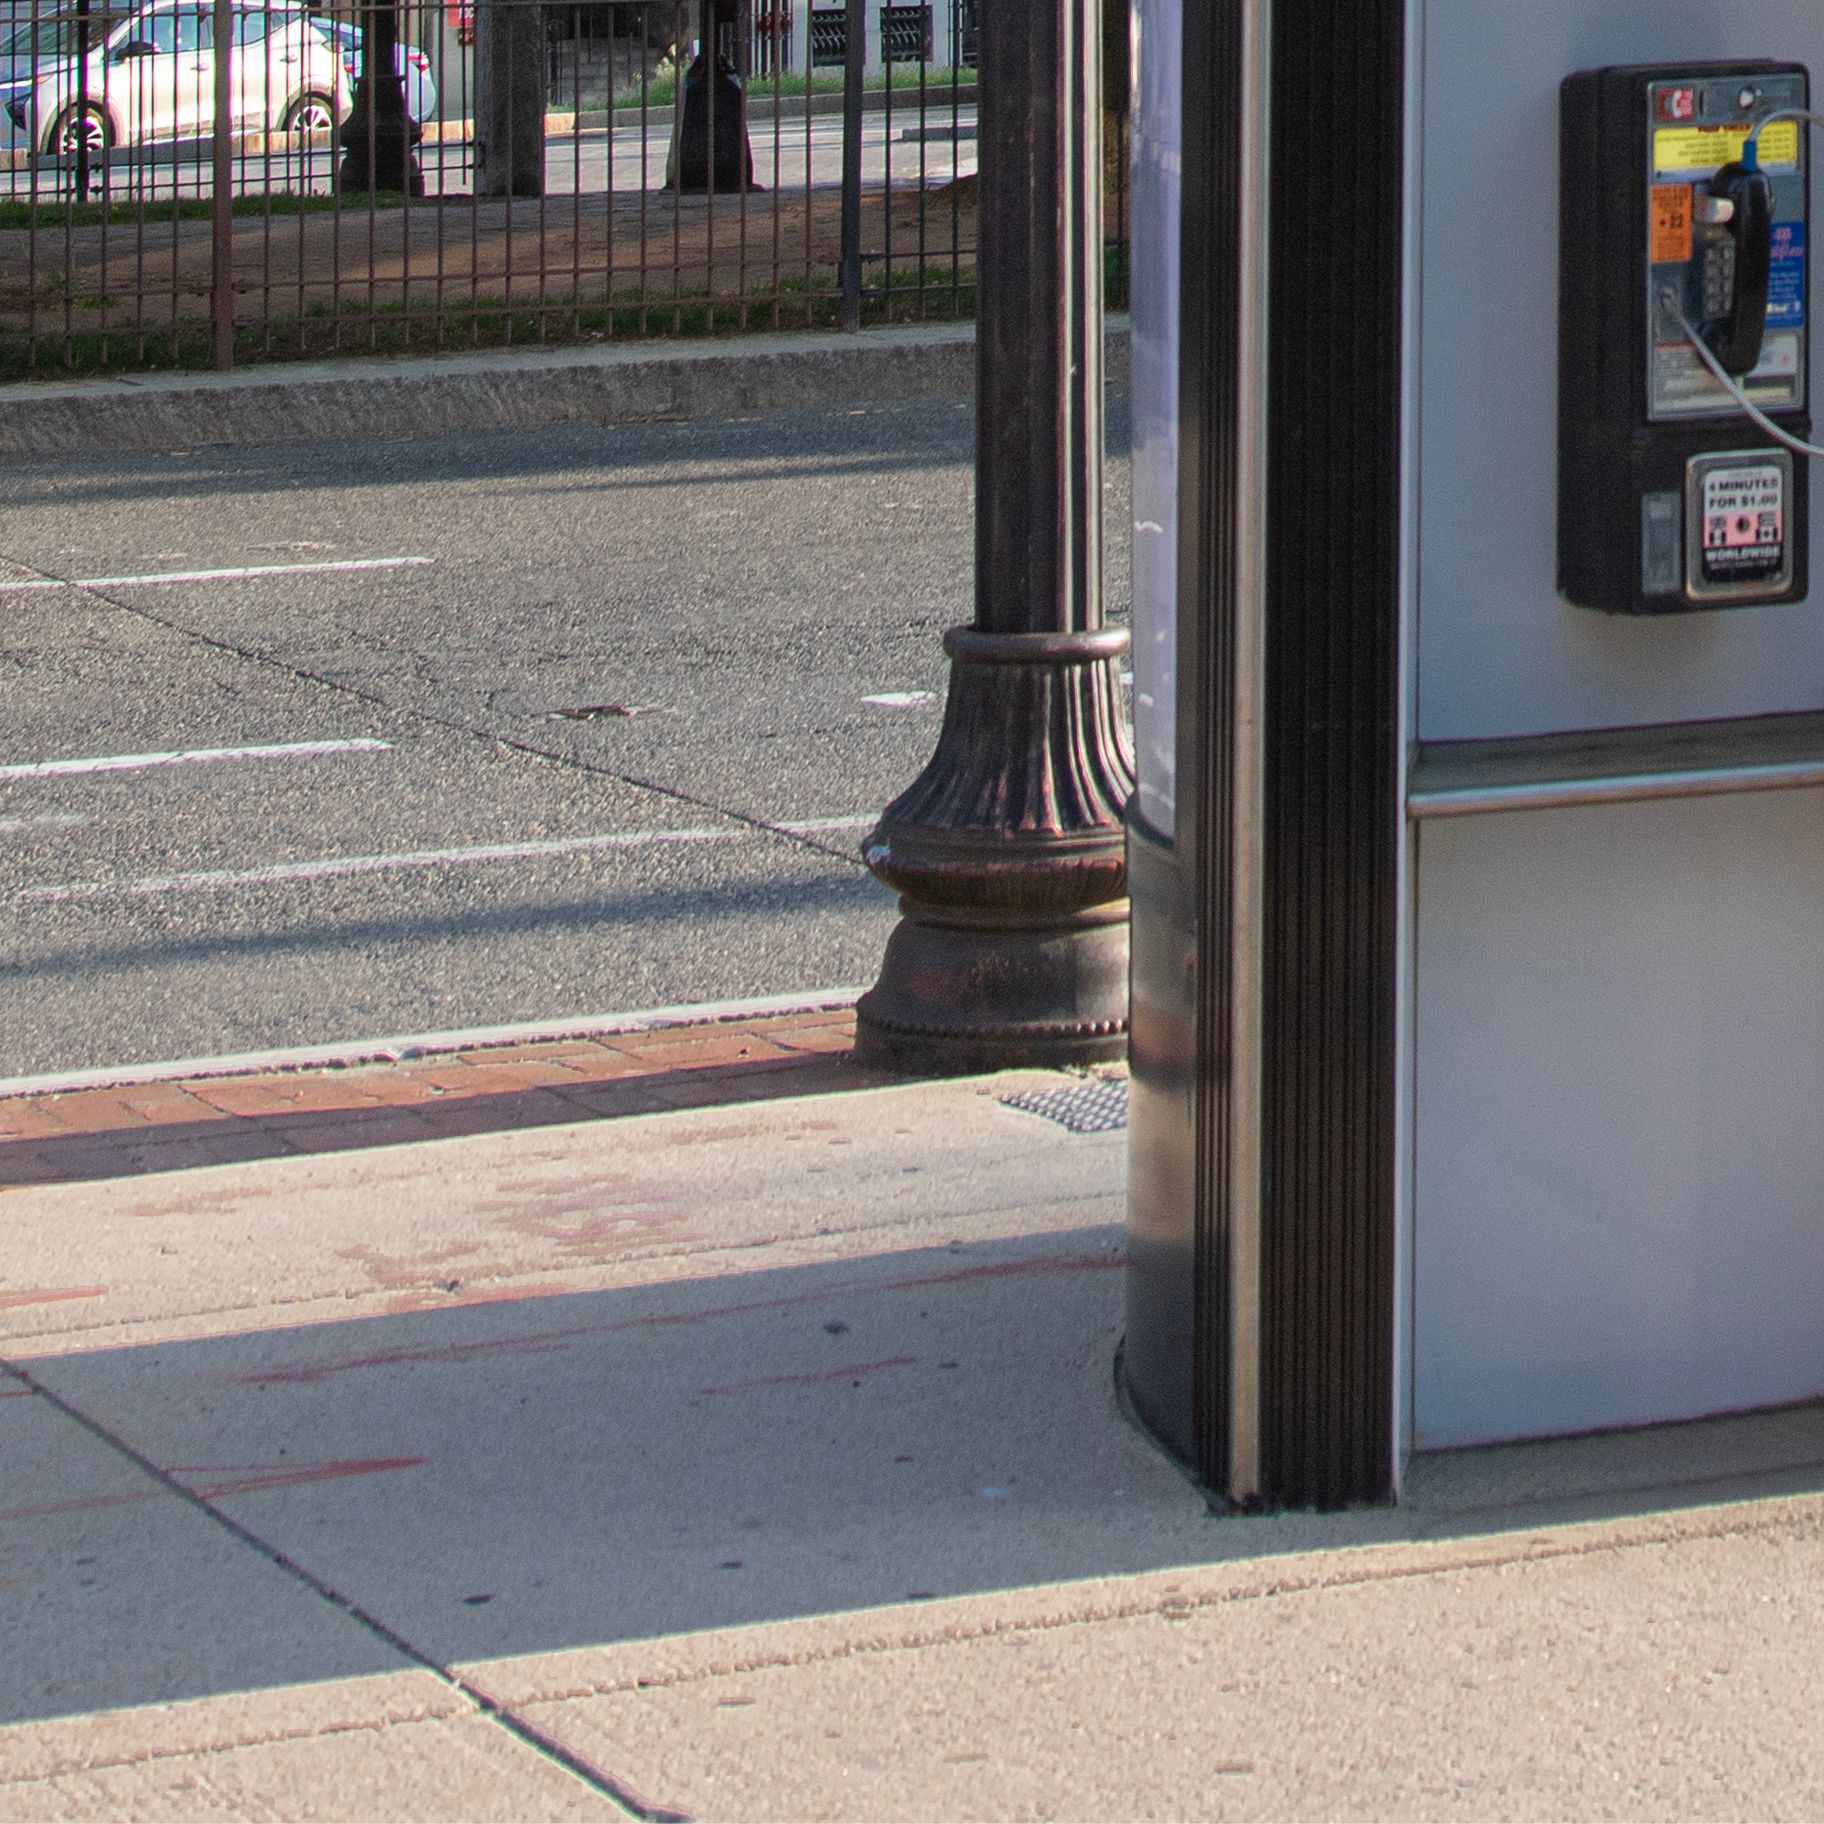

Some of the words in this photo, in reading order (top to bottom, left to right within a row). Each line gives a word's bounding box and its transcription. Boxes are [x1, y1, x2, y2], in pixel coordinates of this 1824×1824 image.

[1719, 478, 1778, 491] MINUTES
[1710, 496, 1737, 508] FOR
[1741, 495, 1778, 507] $1.00
[1706, 546, 1781, 561] WORLDWIDE
